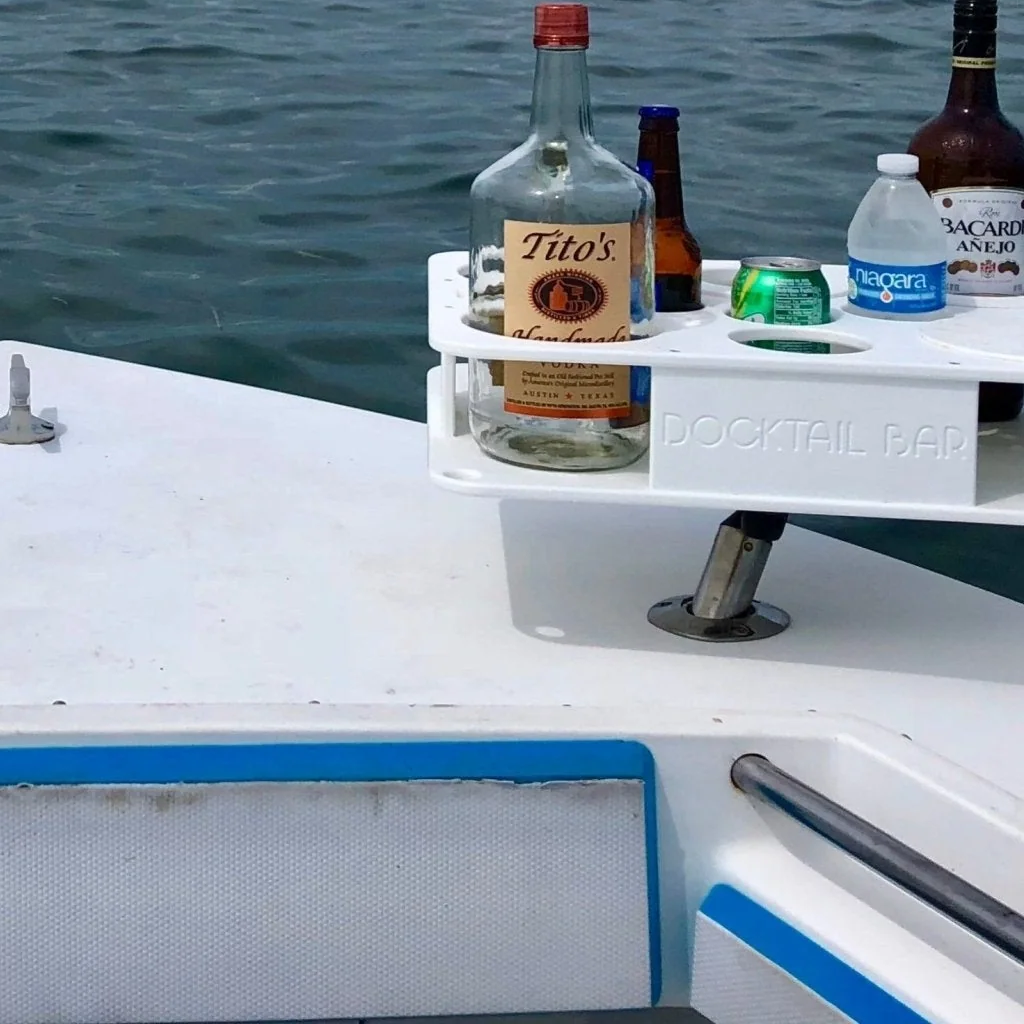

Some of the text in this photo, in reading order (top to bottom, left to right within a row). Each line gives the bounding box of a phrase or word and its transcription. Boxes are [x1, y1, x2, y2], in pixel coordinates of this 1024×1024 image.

[956, 237, 1016, 254] AÑEJO
[856, 268, 927, 294] niagara
[523, 390, 615, 400] AUSTIN TEXAS
[662, 413, 969, 460] DOCKTAIL BAR
